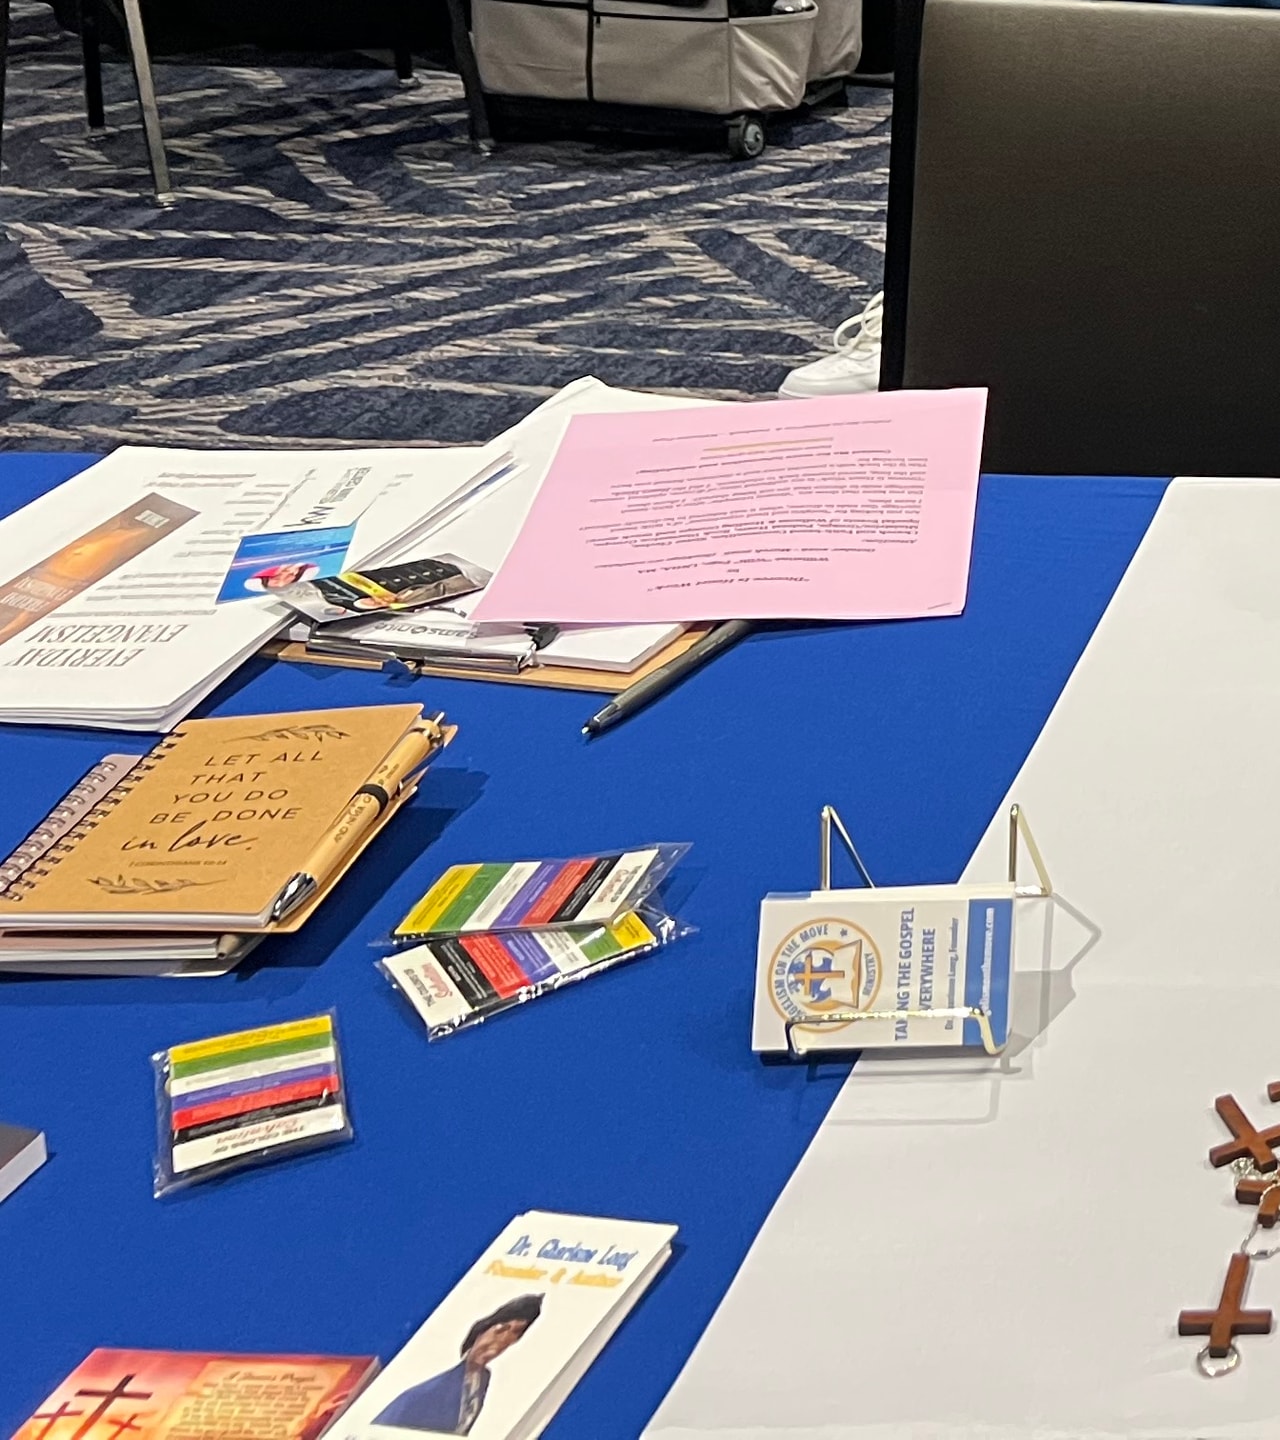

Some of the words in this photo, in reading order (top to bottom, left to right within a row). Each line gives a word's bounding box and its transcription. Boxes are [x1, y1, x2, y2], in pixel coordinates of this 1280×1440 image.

[25, 624, 188, 644] EVANGELISM
[4, 647, 144, 667] EVERYDAY
[204, 754, 260, 767] LET
[270, 750, 323, 762] ALL
[190, 771, 267, 785] THAT
[172, 792, 233, 805] YOU
[243, 789, 288, 801] DO
[149, 812, 192, 825] BE
[211, 808, 302, 822] DONE
[121, 836, 157, 851] in
[167, 820, 261, 853] love.
[798, 924, 829, 943] MOVE
[898, 908, 915, 960] GOSPEL
[780, 940, 801, 957] THE
[774, 961, 787, 976] ON
[862, 951, 878, 997] MINISTRY
[897, 961, 912, 989] THE
[919, 928, 936, 1012] VERYWHERE
[506, 1235, 532, 1257] Dr.
[597, 1244, 639, 1272] Long
